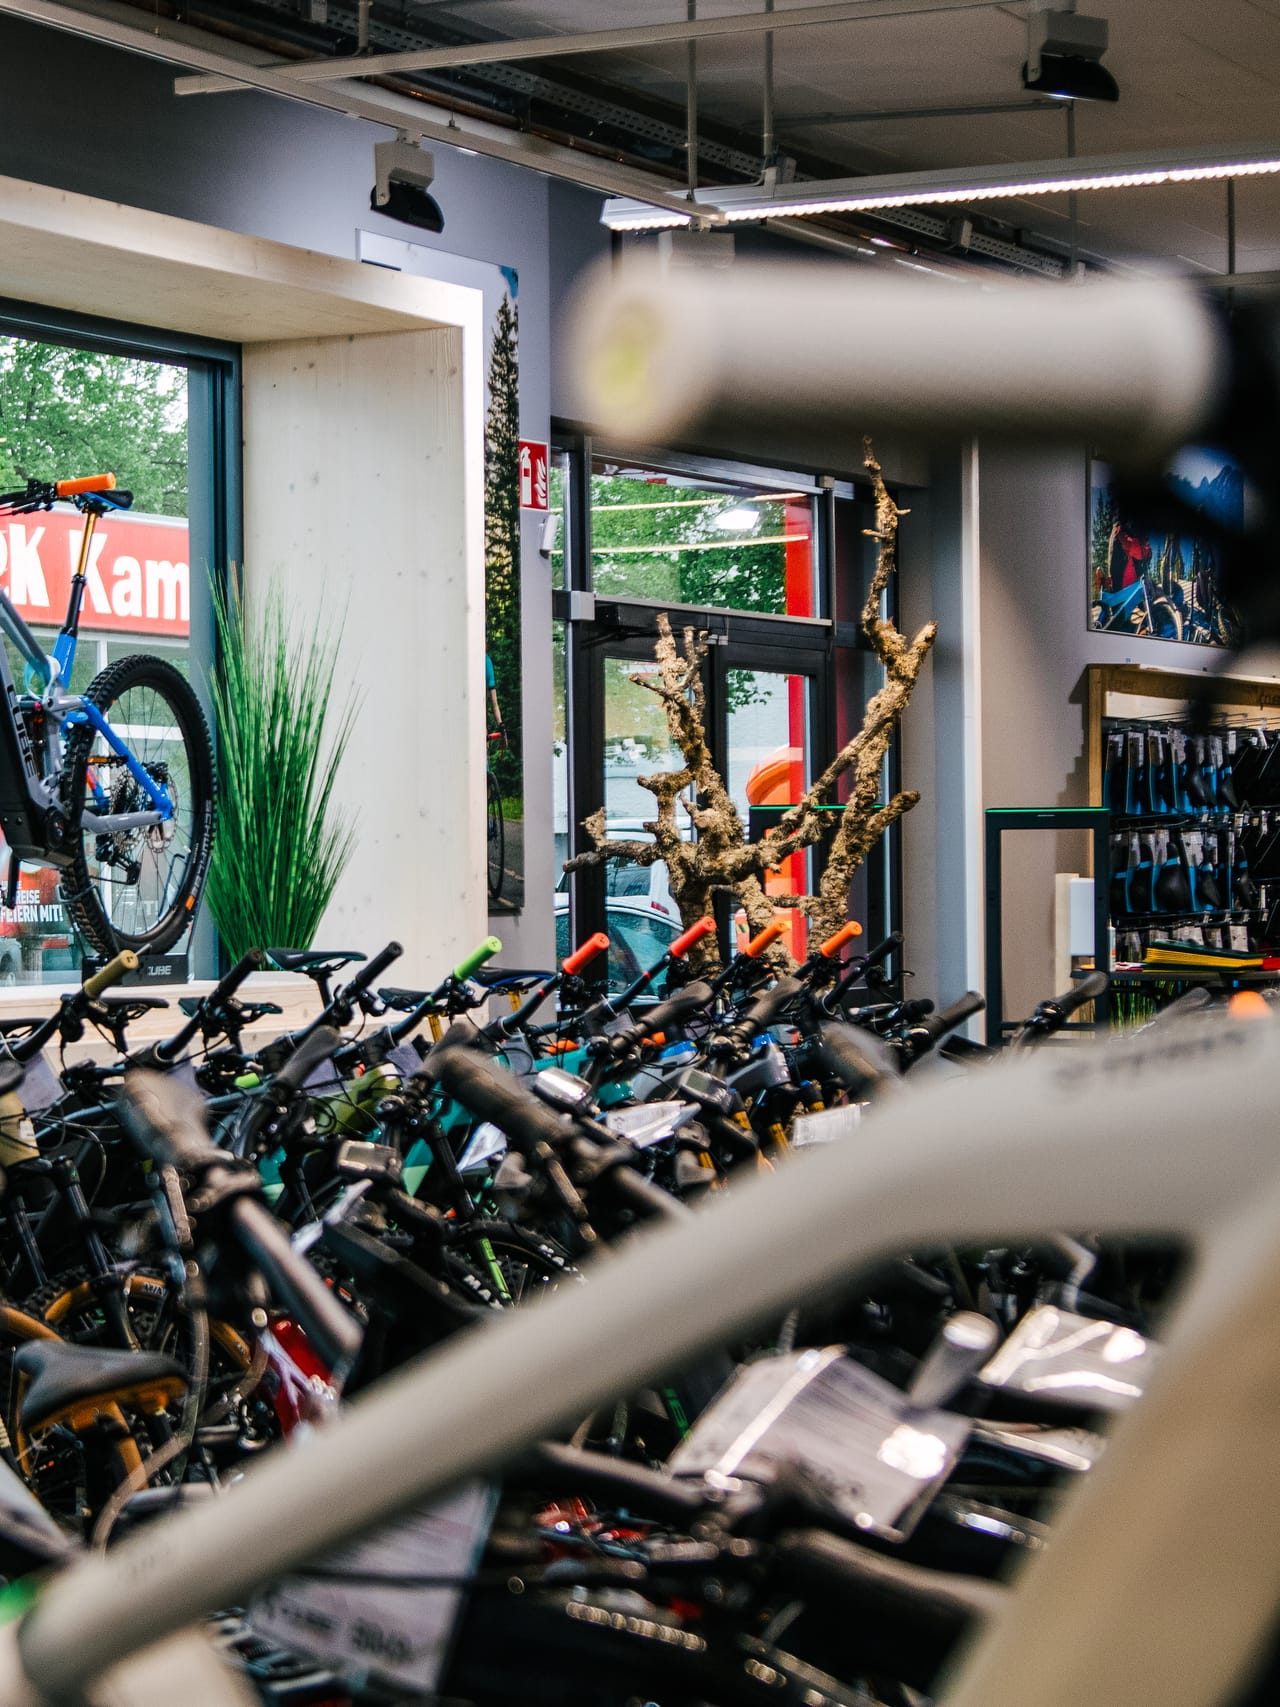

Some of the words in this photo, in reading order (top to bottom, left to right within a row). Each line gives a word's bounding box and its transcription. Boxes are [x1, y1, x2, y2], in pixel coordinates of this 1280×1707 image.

[69, 528, 190, 621] Kam
[6, 684, 38, 779] CUBE
[190, 799, 213, 898] SCHWALBE
[39, 904, 64, 922] MIT!
